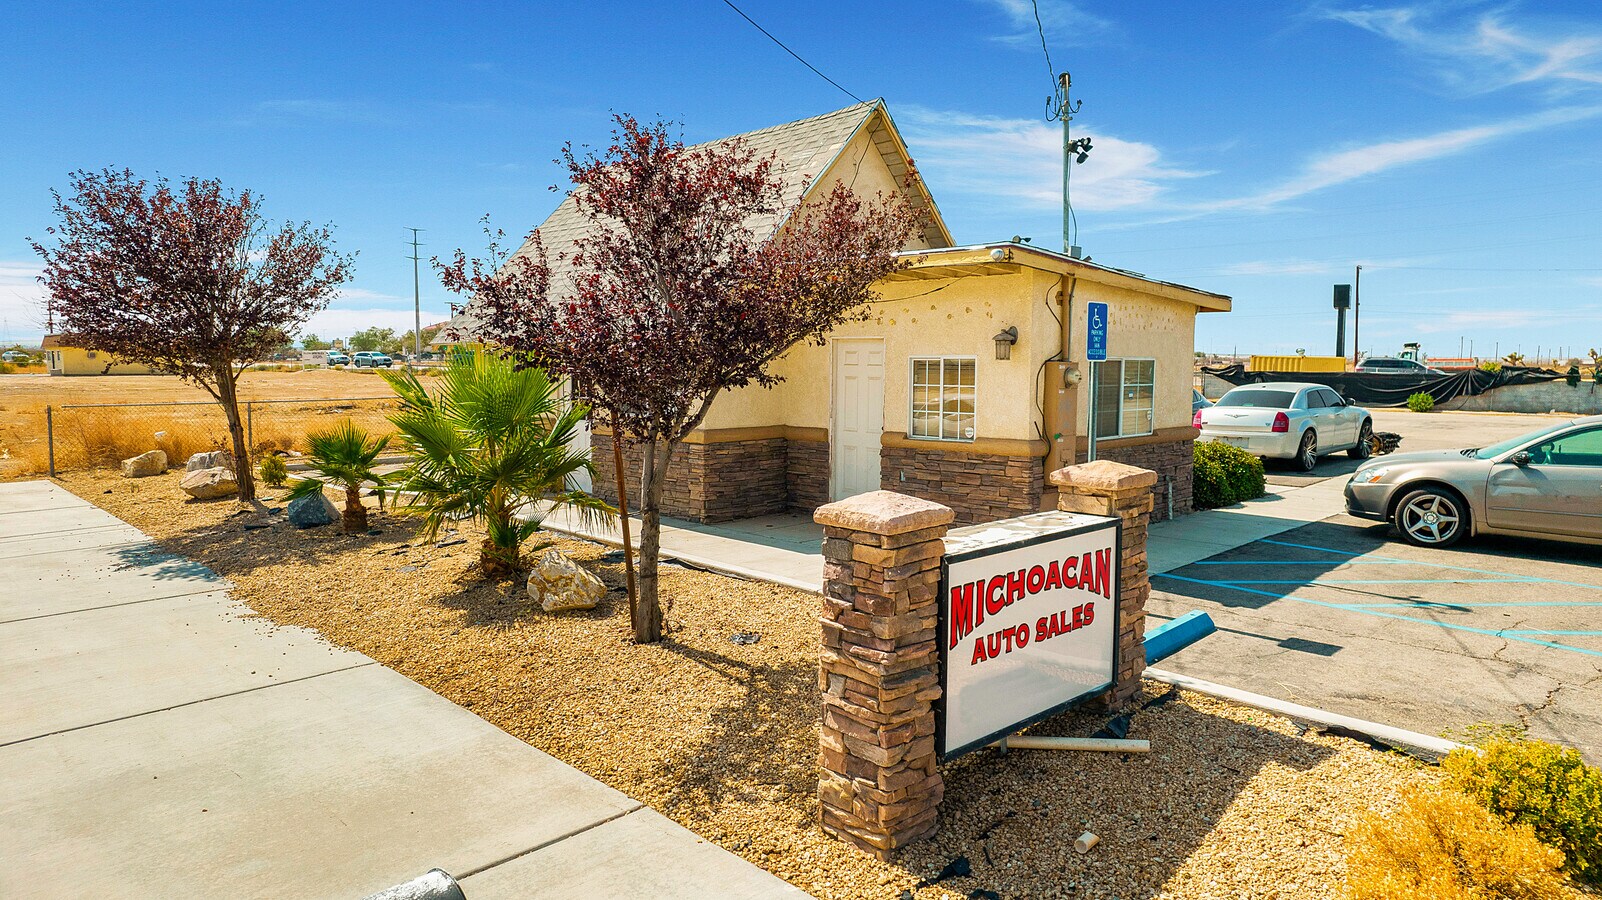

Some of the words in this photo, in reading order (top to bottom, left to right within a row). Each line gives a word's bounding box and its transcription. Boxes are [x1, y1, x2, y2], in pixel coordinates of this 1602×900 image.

[949, 547, 1112, 651] MICHOACAN
[971, 623, 1030, 665] AUTO
[1035, 602, 1095, 642] SALES
